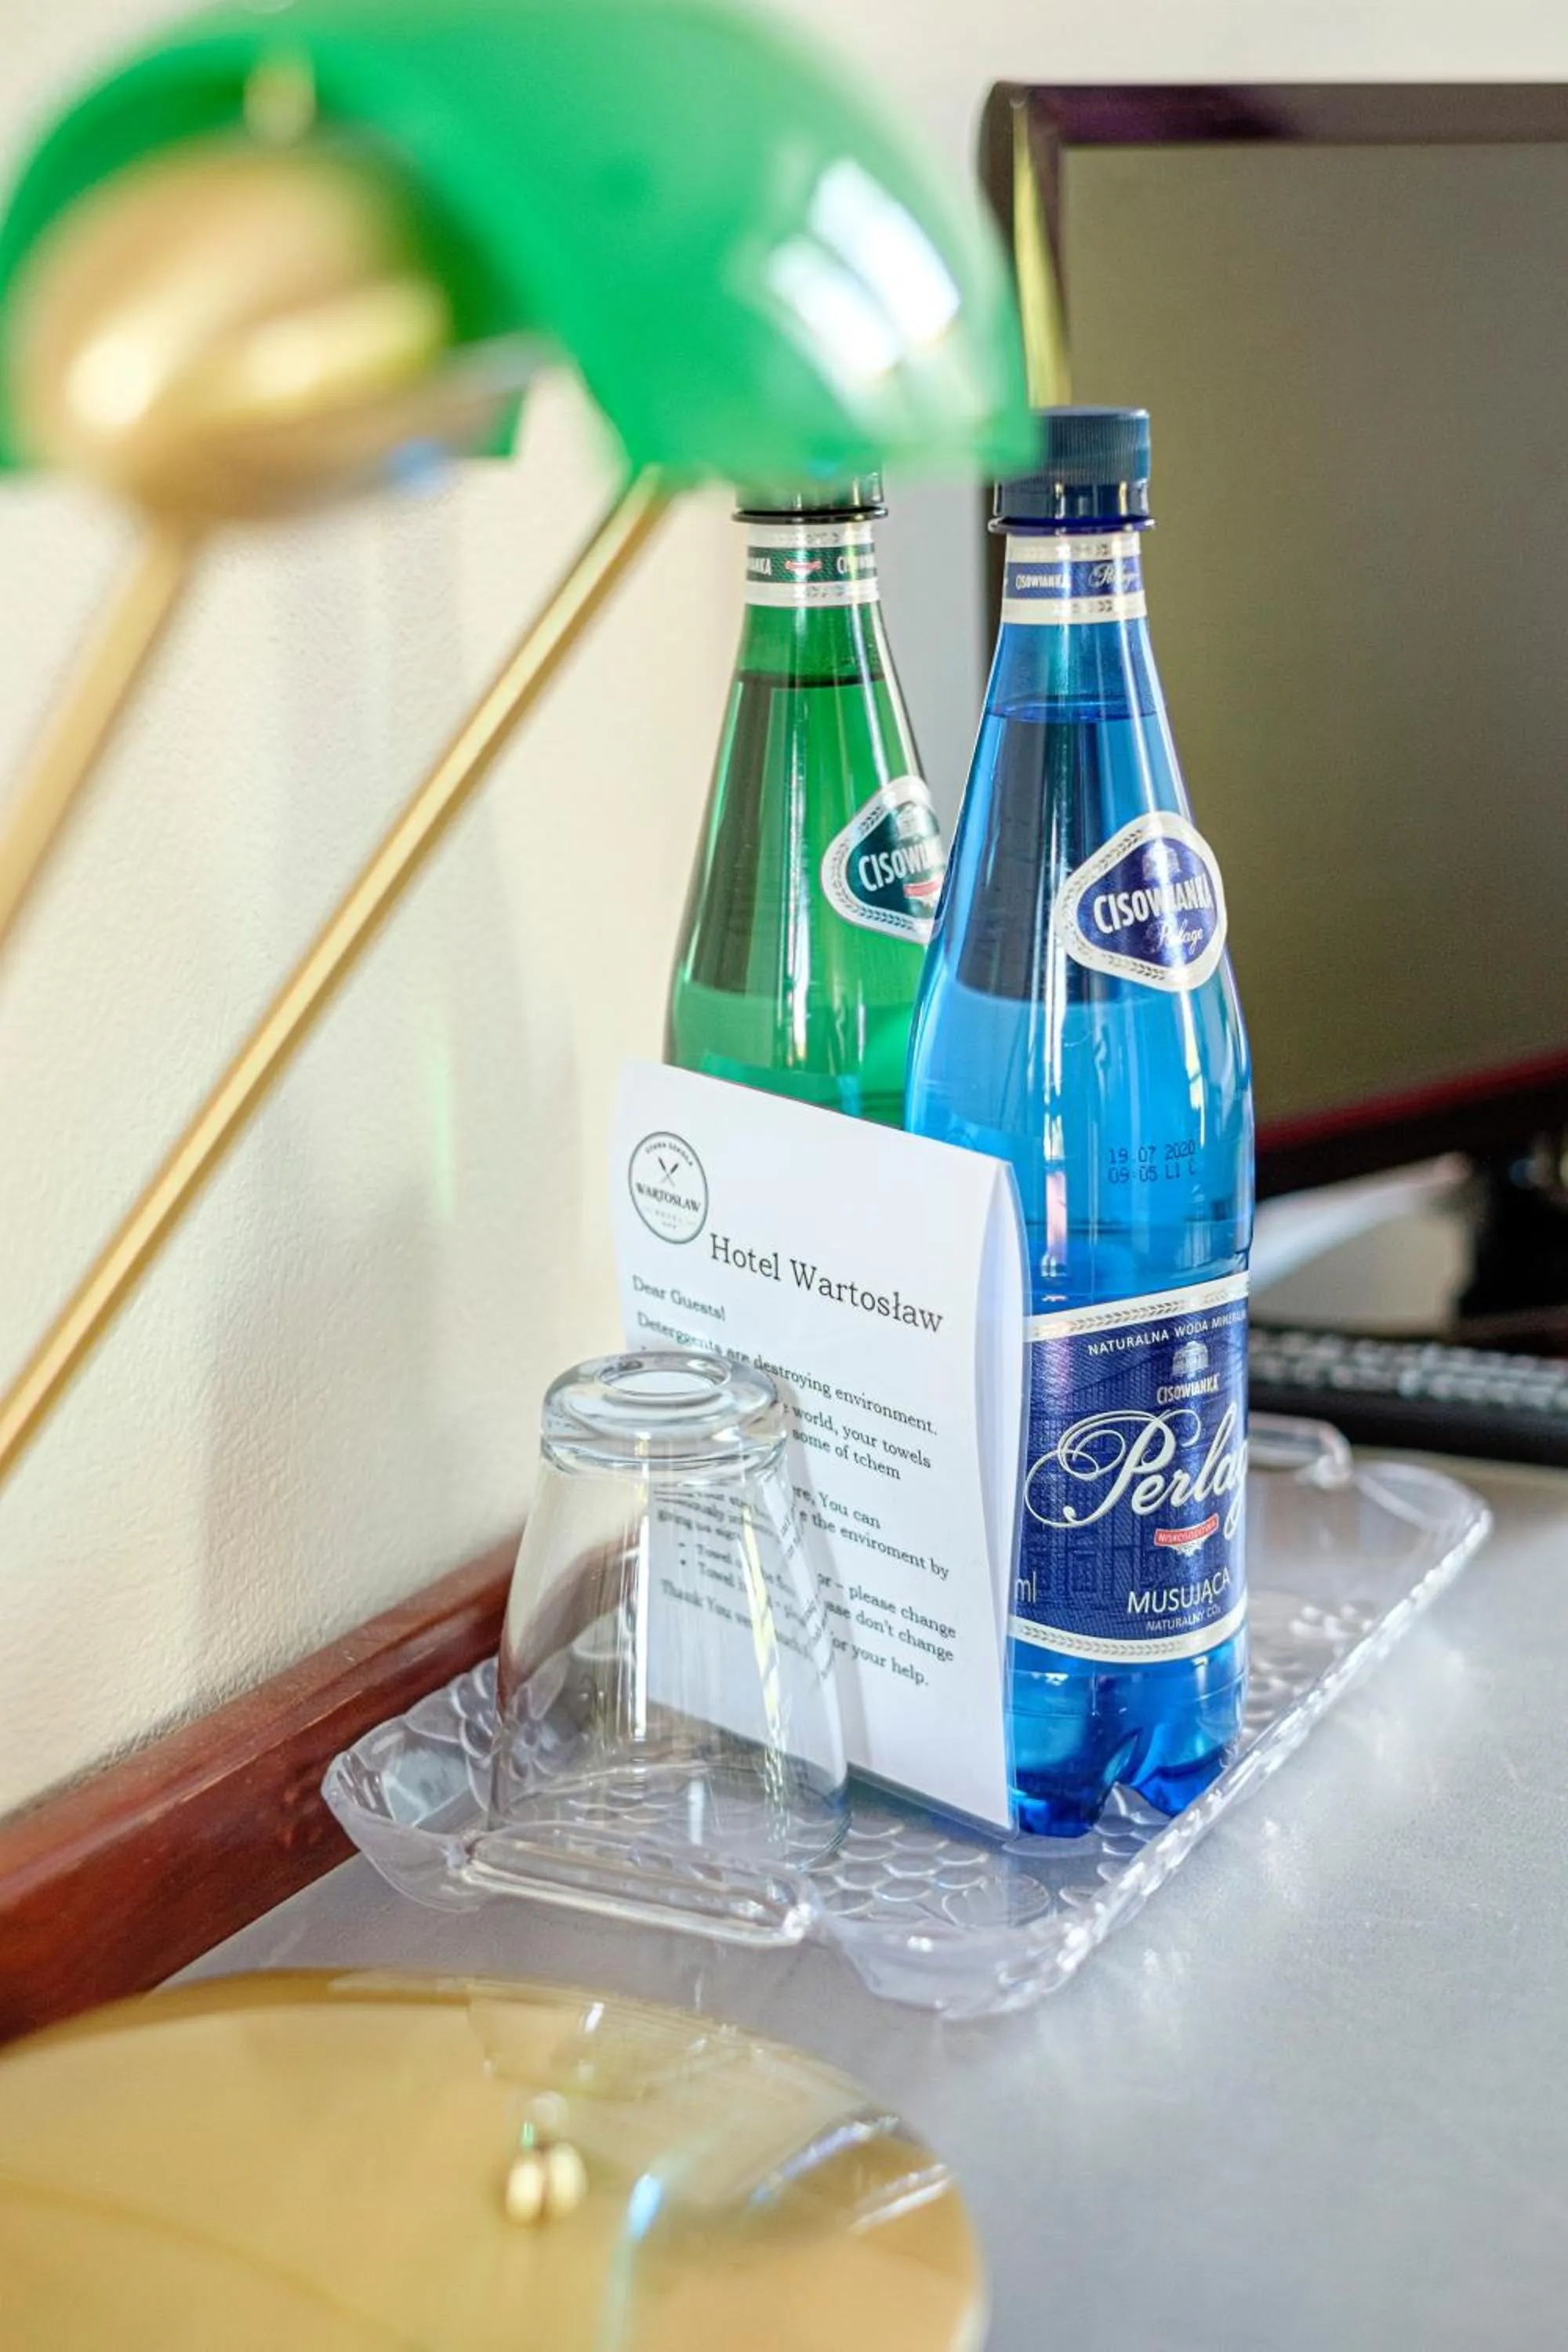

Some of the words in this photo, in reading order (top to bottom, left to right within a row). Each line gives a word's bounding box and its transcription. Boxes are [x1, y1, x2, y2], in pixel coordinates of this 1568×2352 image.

[633, 1274, 666, 1299] Dear
[710, 1232, 781, 1281] Hotel
[789, 1258, 943, 1333] Wartosław
[1088, 1328, 1169, 1356] NATURALNA
[1174, 1319, 1208, 1338] WODA
[727, 1348, 750, 1363] are
[754, 1355, 832, 1399] destroying
[835, 1392, 938, 1436] environment.
[1156, 1373, 1220, 1406] CISOWIANKA
[792, 1406, 838, 1436] world,
[843, 1425, 878, 1449] your
[882, 1439, 931, 1468] towels
[792, 1429, 830, 1452] some
[835, 1445, 849, 1460] of
[853, 1452, 901, 1479] tchem
[818, 1492, 848, 1516] You
[853, 1510, 881, 1529] can
[812, 1512, 836, 1533] the
[840, 1527, 926, 1569] enviroment
[930, 1557, 949, 1581] by
[849, 1584, 896, 1614] please
[901, 1606, 956, 1639] change
[1127, 1566, 1230, 1614] MUSUJĄCA
[855, 1610, 894, 1638] don't
[898, 1629, 953, 1661] change
[1145, 1610, 1206, 1632] NATURALNY
[851, 1644, 887, 1668] your
[891, 1657, 929, 1686] help.
